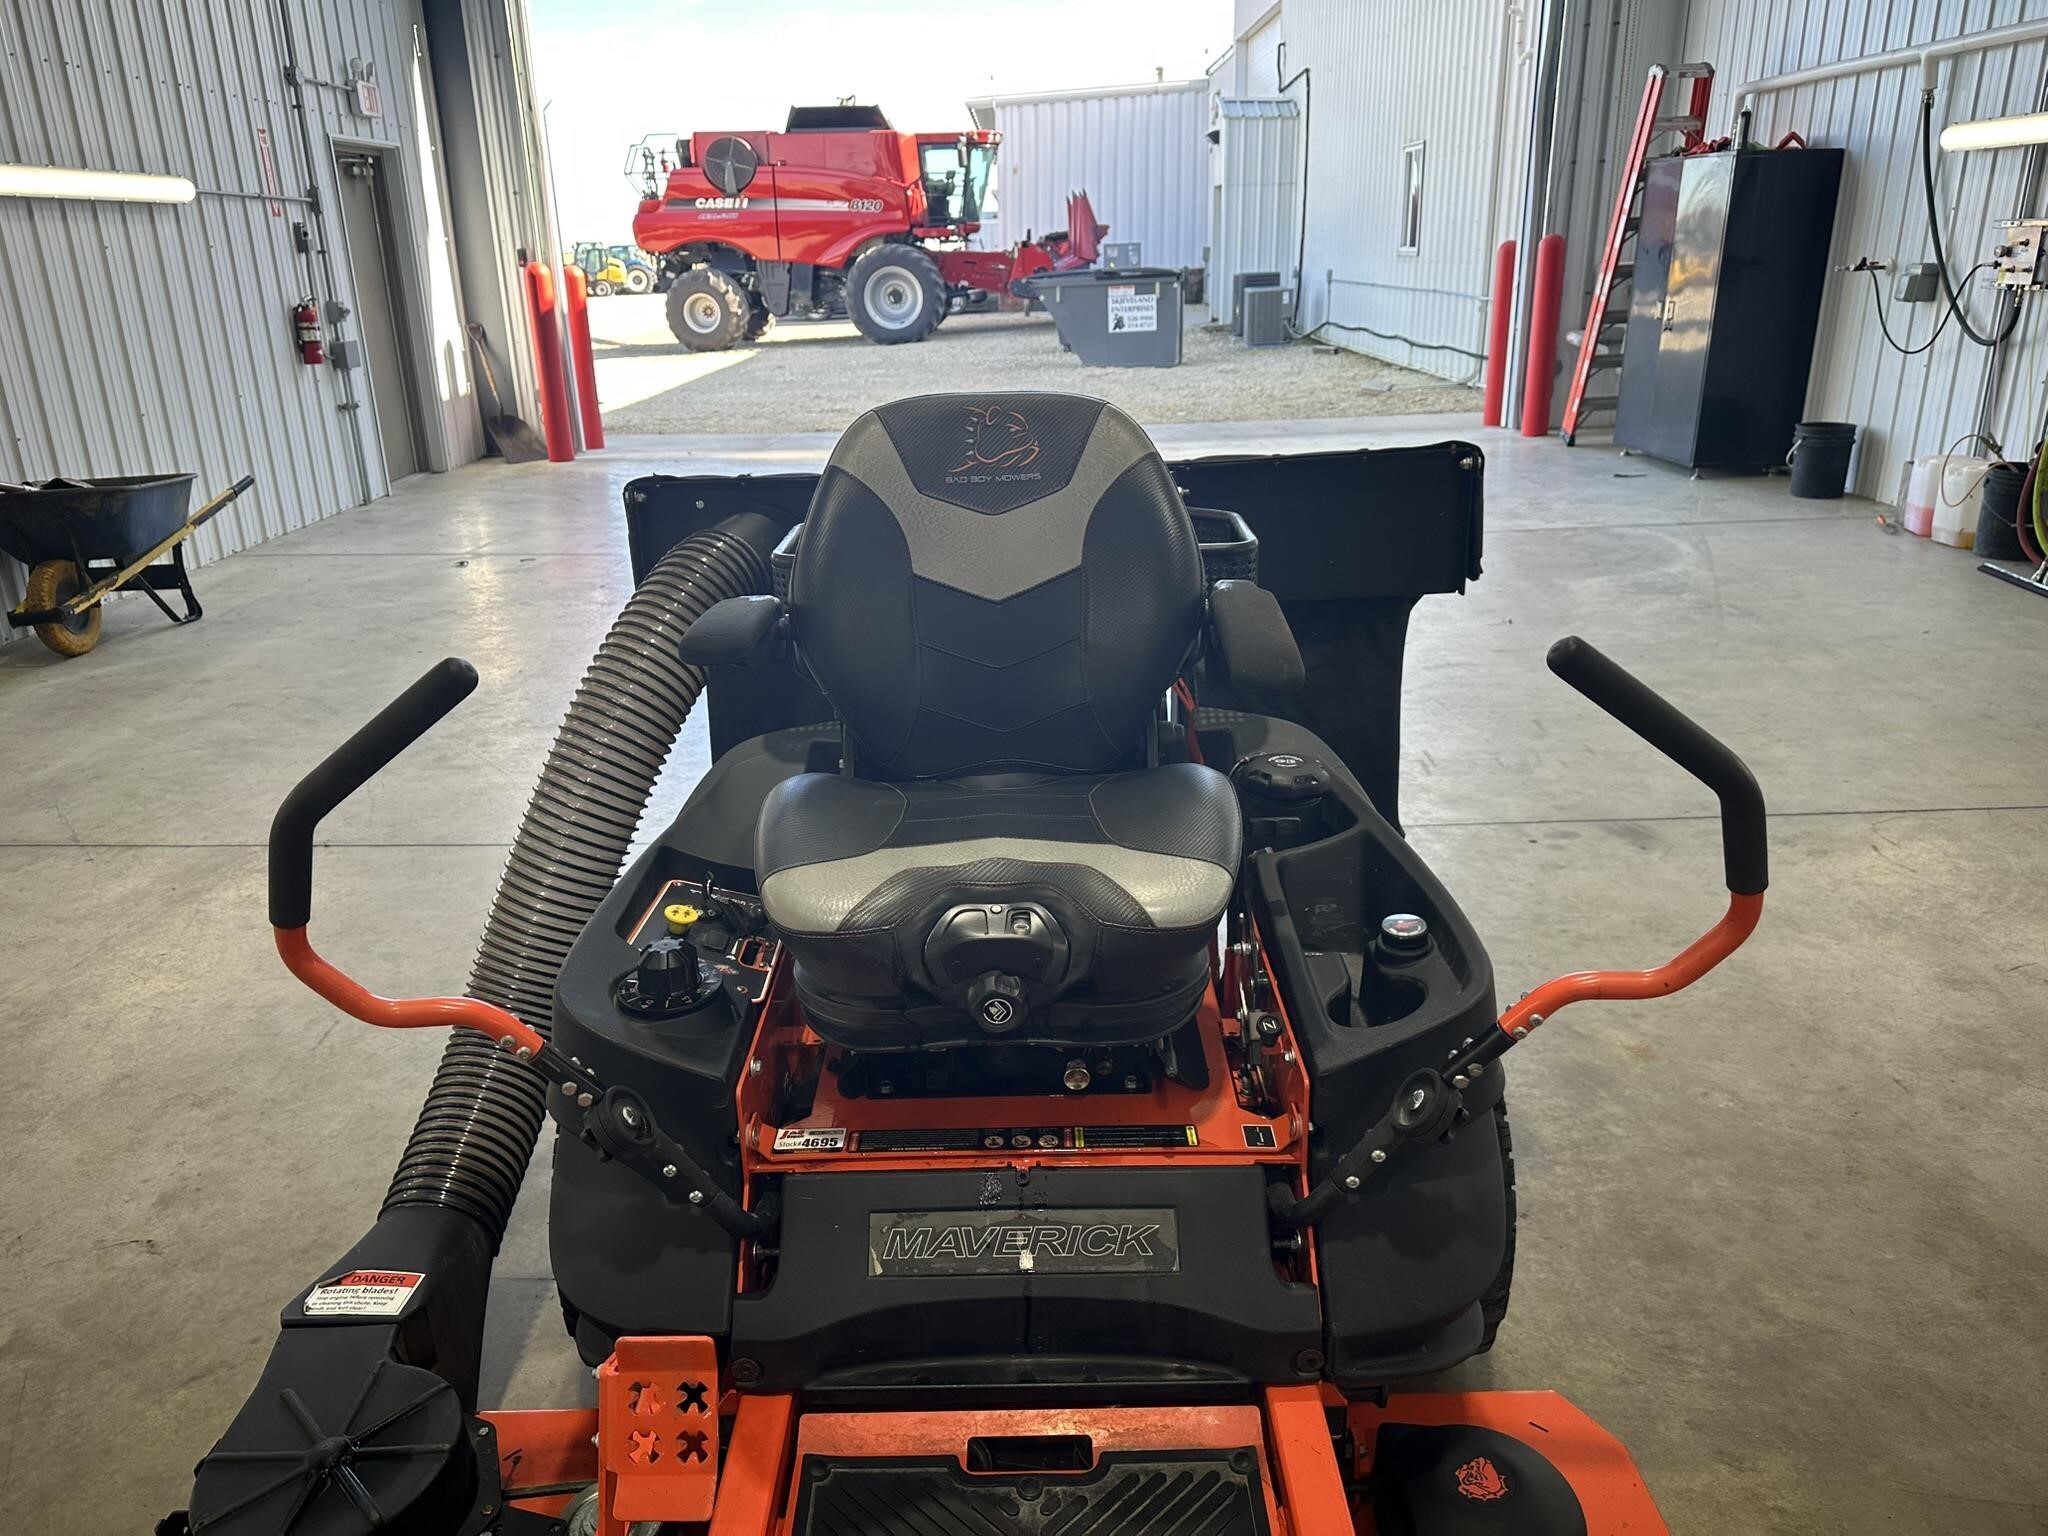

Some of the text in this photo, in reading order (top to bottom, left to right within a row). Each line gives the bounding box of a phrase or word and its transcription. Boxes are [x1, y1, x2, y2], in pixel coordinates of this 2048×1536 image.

[850, 199, 884, 213] 8120
[945, 472, 1042, 484] BAD BOY MOWERS
[801, 1137, 839, 1148] 4695
[883, 1224, 1160, 1260] MAVERICK
[351, 1274, 407, 1284] DANGER
[320, 1287, 399, 1295] Rotating blades!
